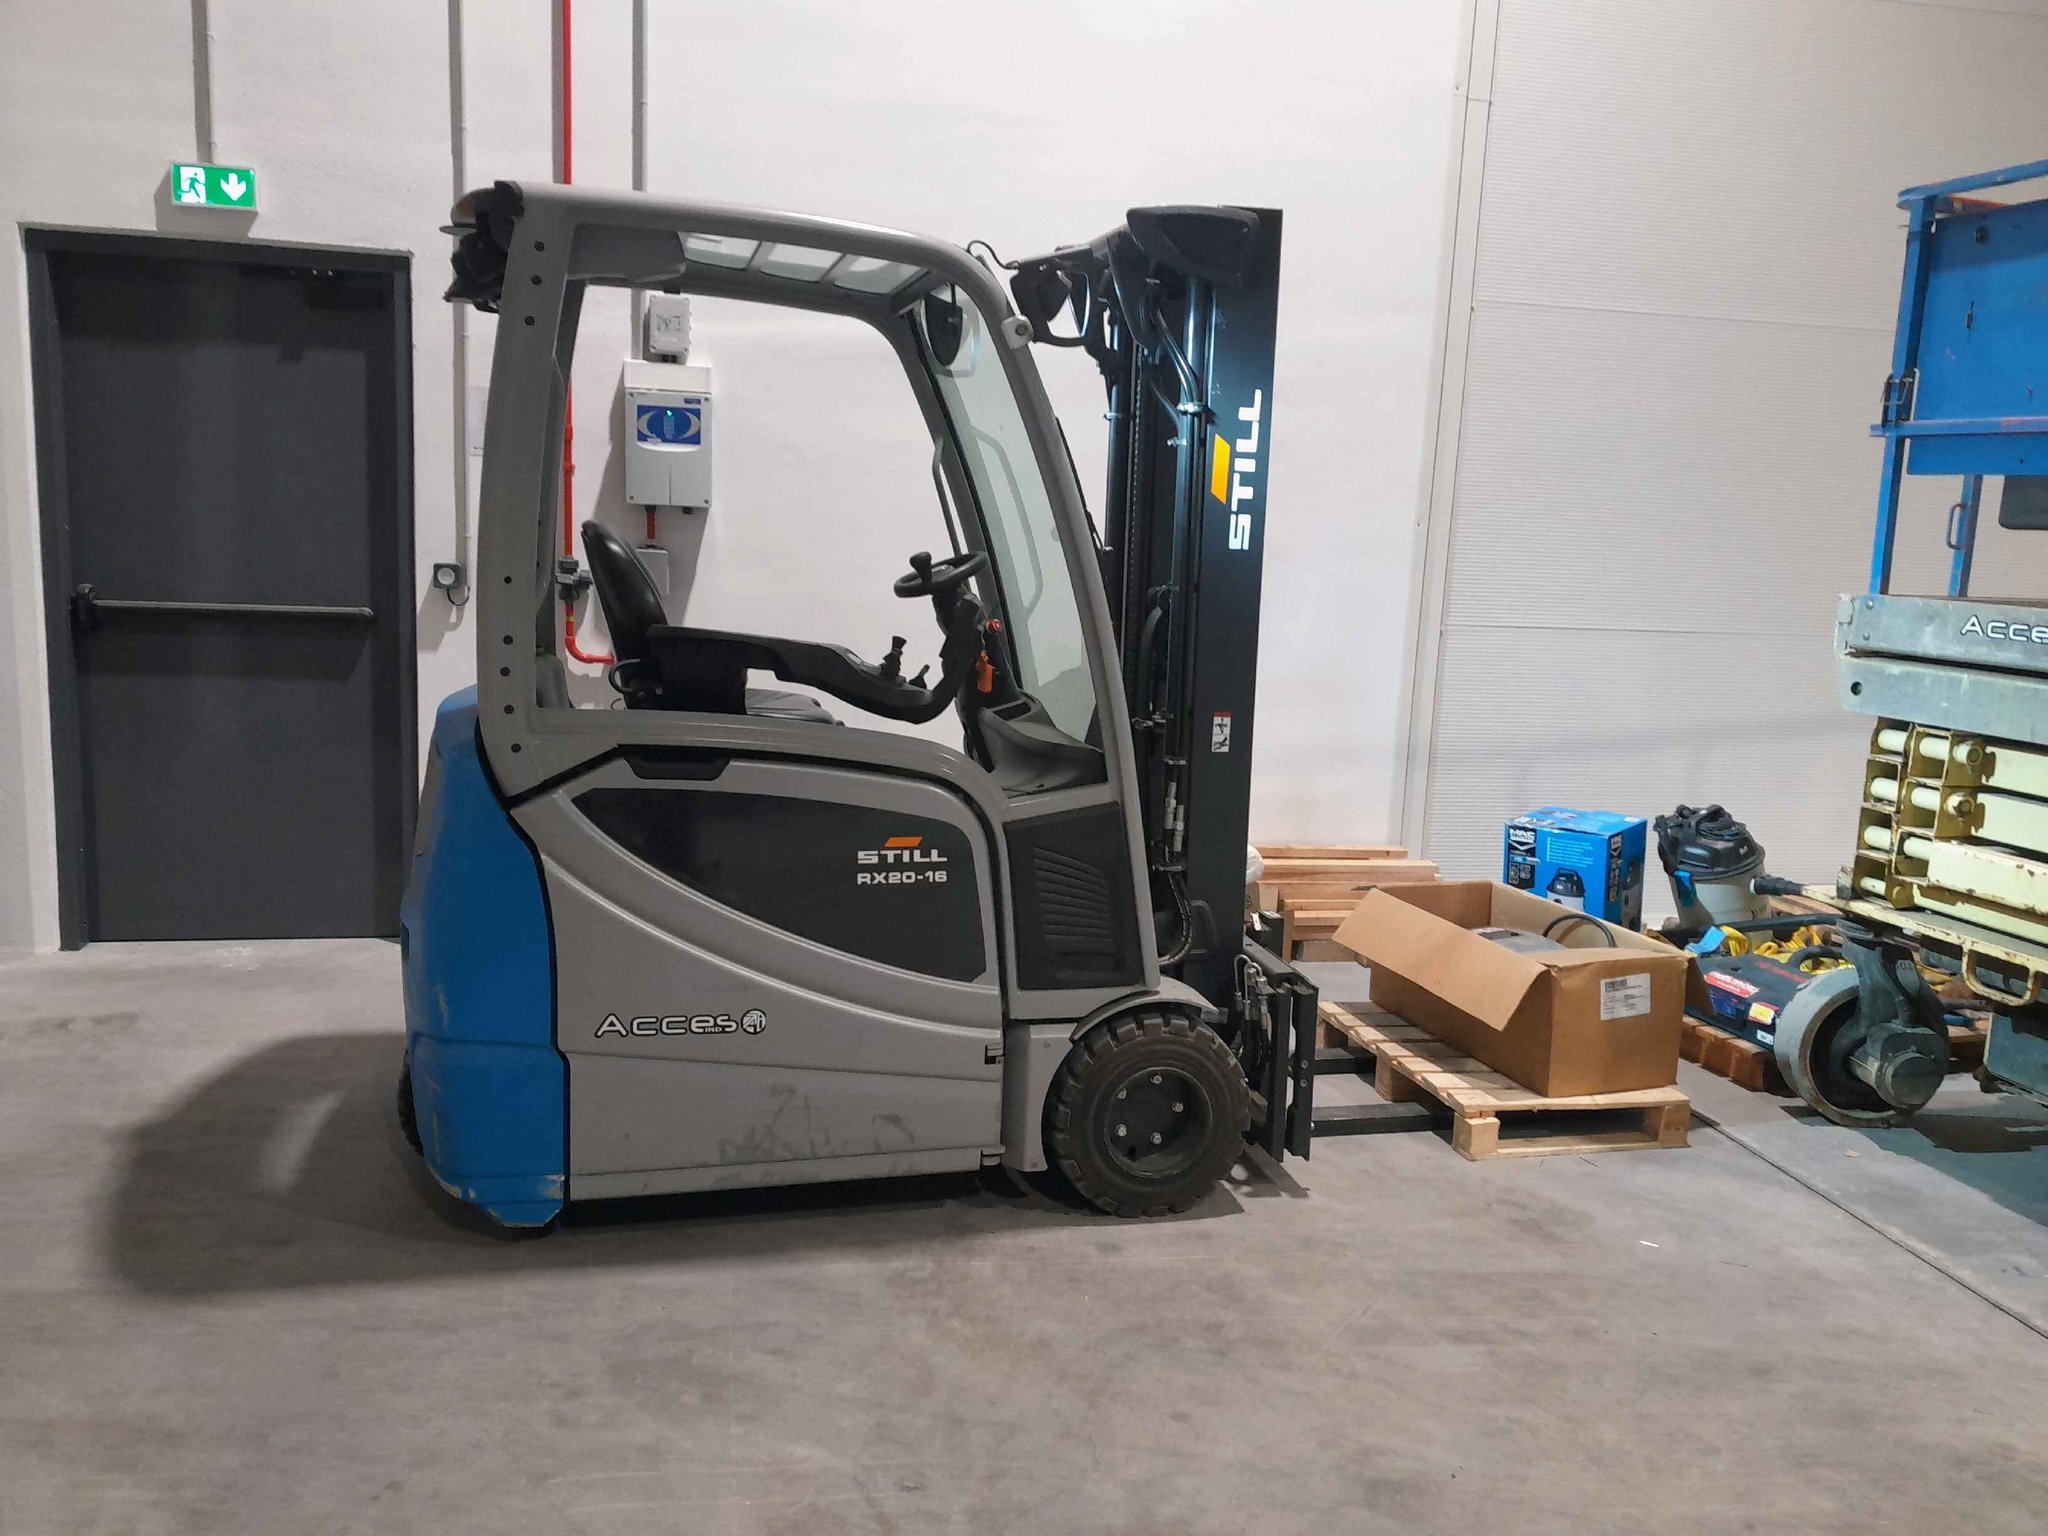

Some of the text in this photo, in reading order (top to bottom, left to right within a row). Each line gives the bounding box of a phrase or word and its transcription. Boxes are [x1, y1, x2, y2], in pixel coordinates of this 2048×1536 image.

[1228, 389, 1262, 550] STILL
[857, 849, 948, 864] STILL
[857, 870, 948, 885] RX20-16
[595, 1013, 738, 1038] Acces
